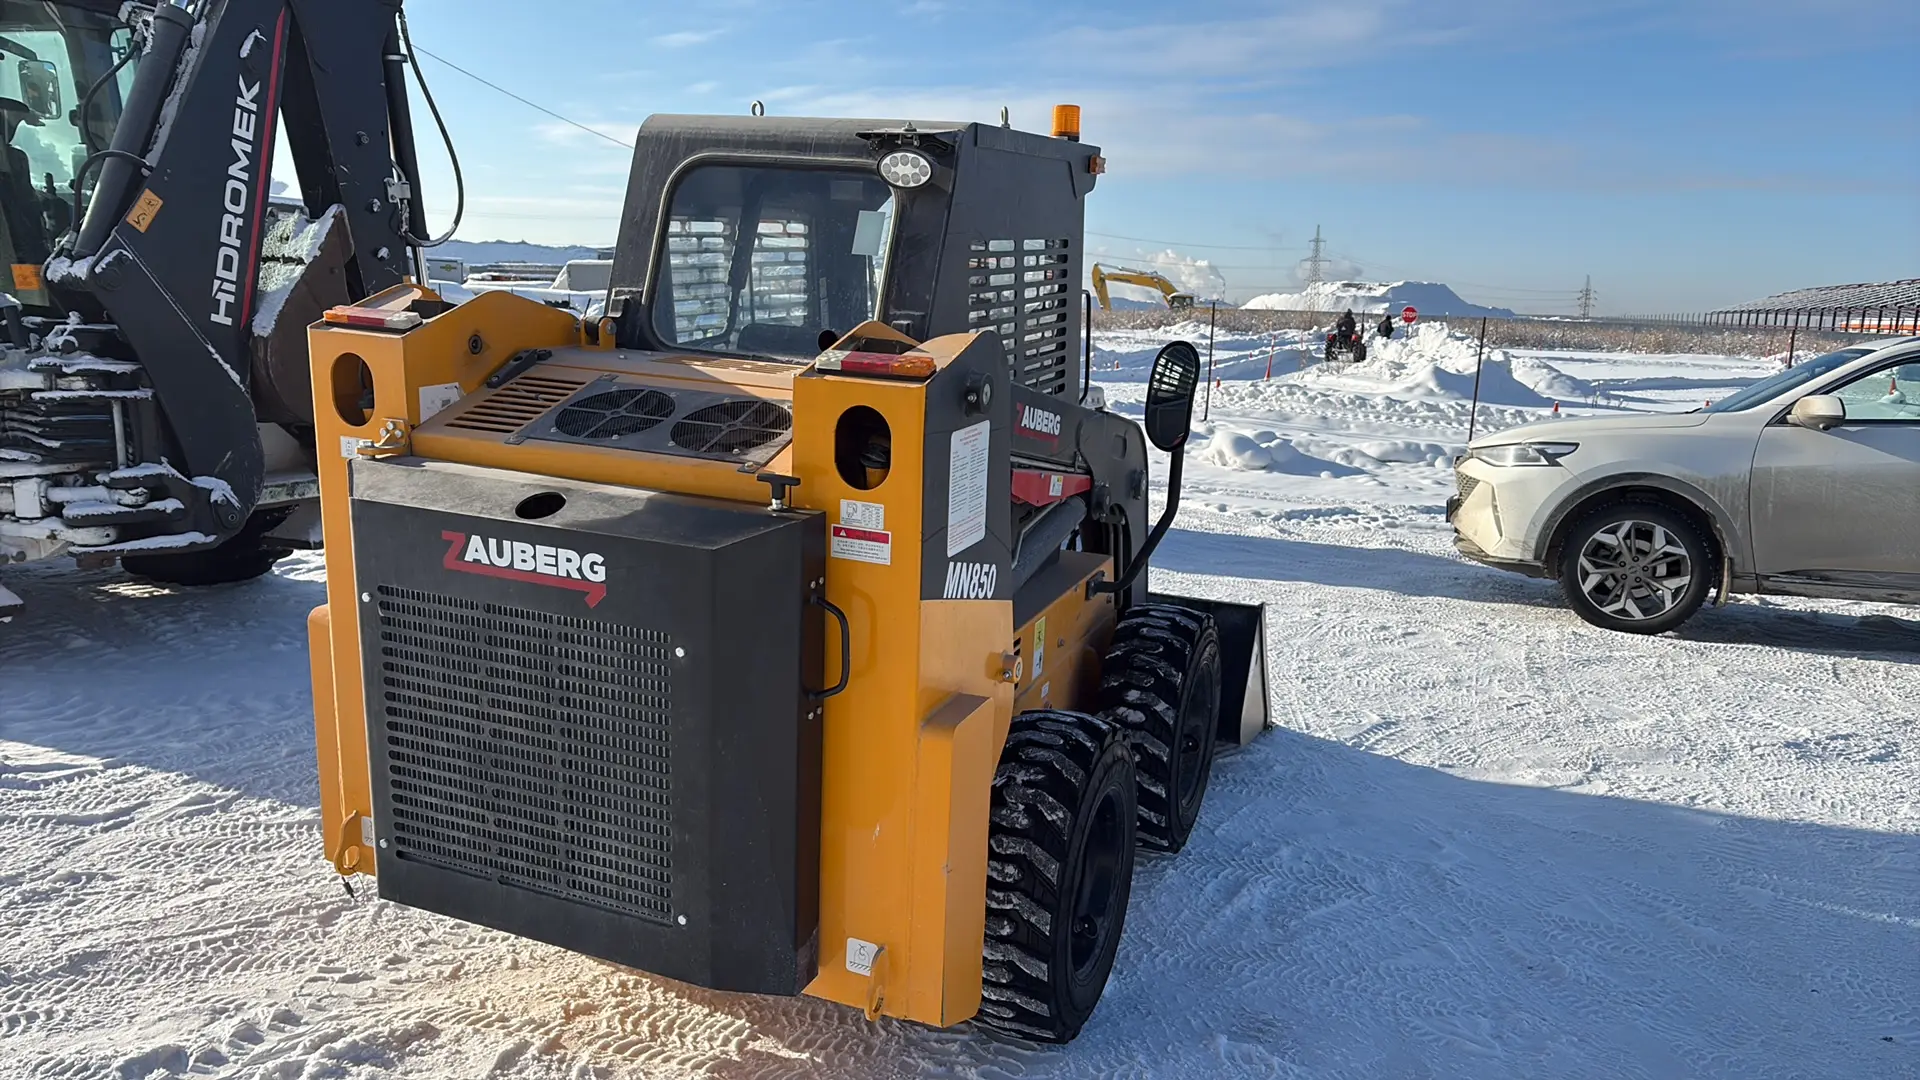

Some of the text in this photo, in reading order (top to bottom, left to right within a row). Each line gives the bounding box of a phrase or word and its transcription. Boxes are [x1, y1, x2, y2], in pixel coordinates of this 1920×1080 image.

[1014, 402, 1061, 444] ZAUBERG
[441, 530, 607, 595] ZAUBERG
[943, 561, 997, 599] MN850
